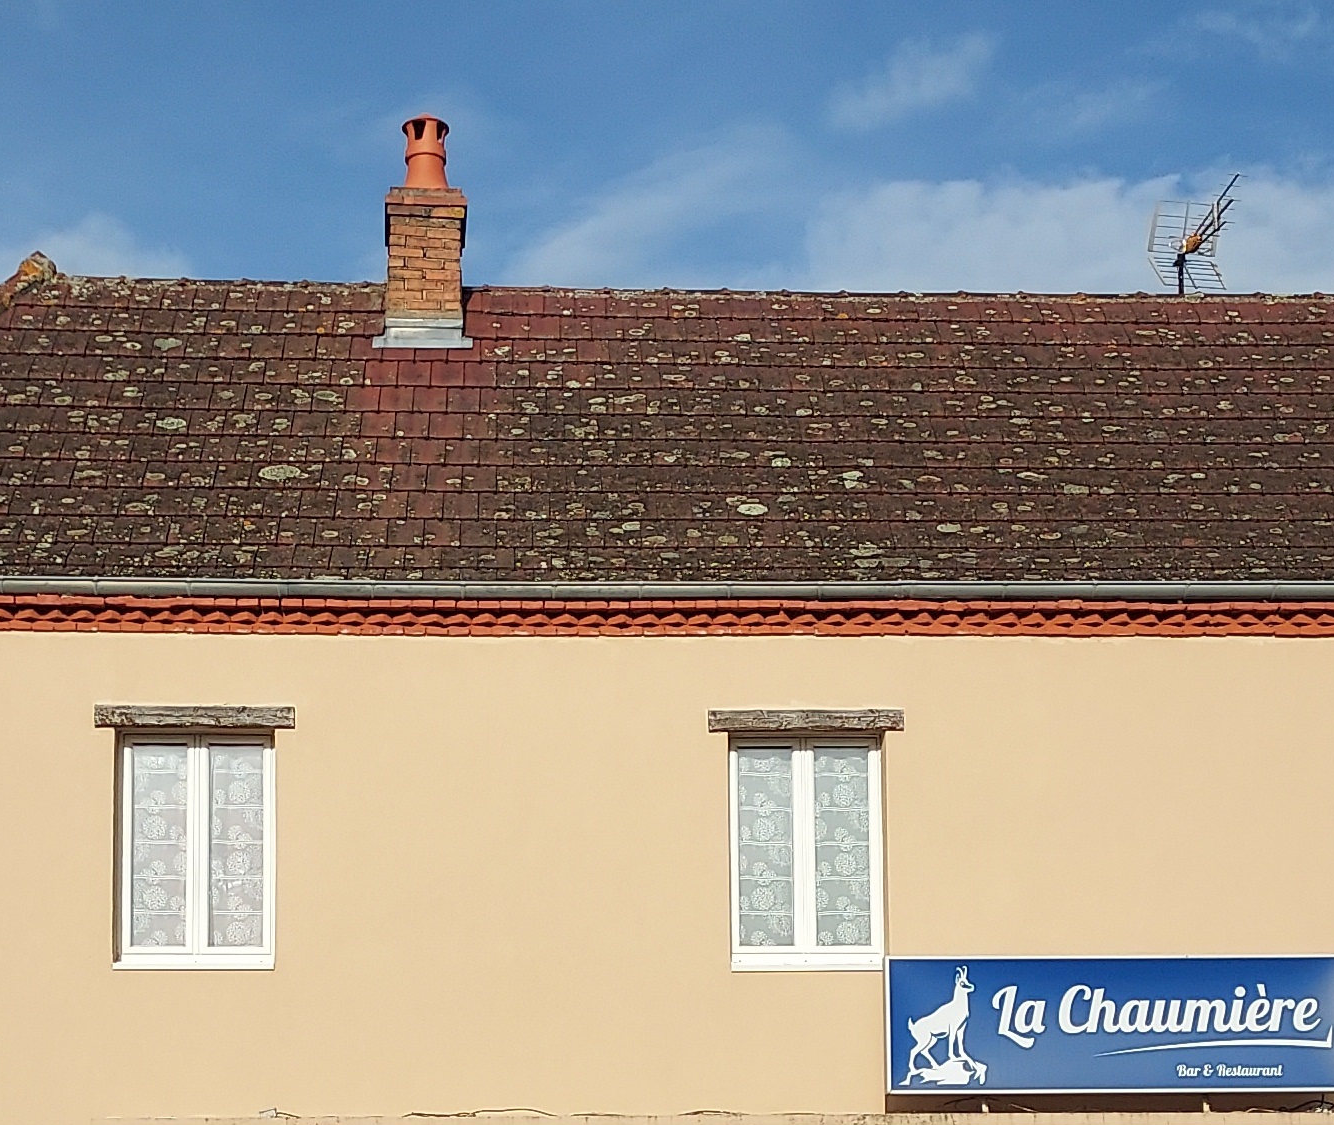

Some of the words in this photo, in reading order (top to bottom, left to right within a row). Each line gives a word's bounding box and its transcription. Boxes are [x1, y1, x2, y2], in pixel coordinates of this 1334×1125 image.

[991, 985, 1046, 1050] La
[1058, 982, 1322, 1035] Chaumière
[1176, 1063, 1201, 1078] Bar
[1203, 1063, 1214, 1077] &
[1216, 1063, 1284, 1078] Restaurant
